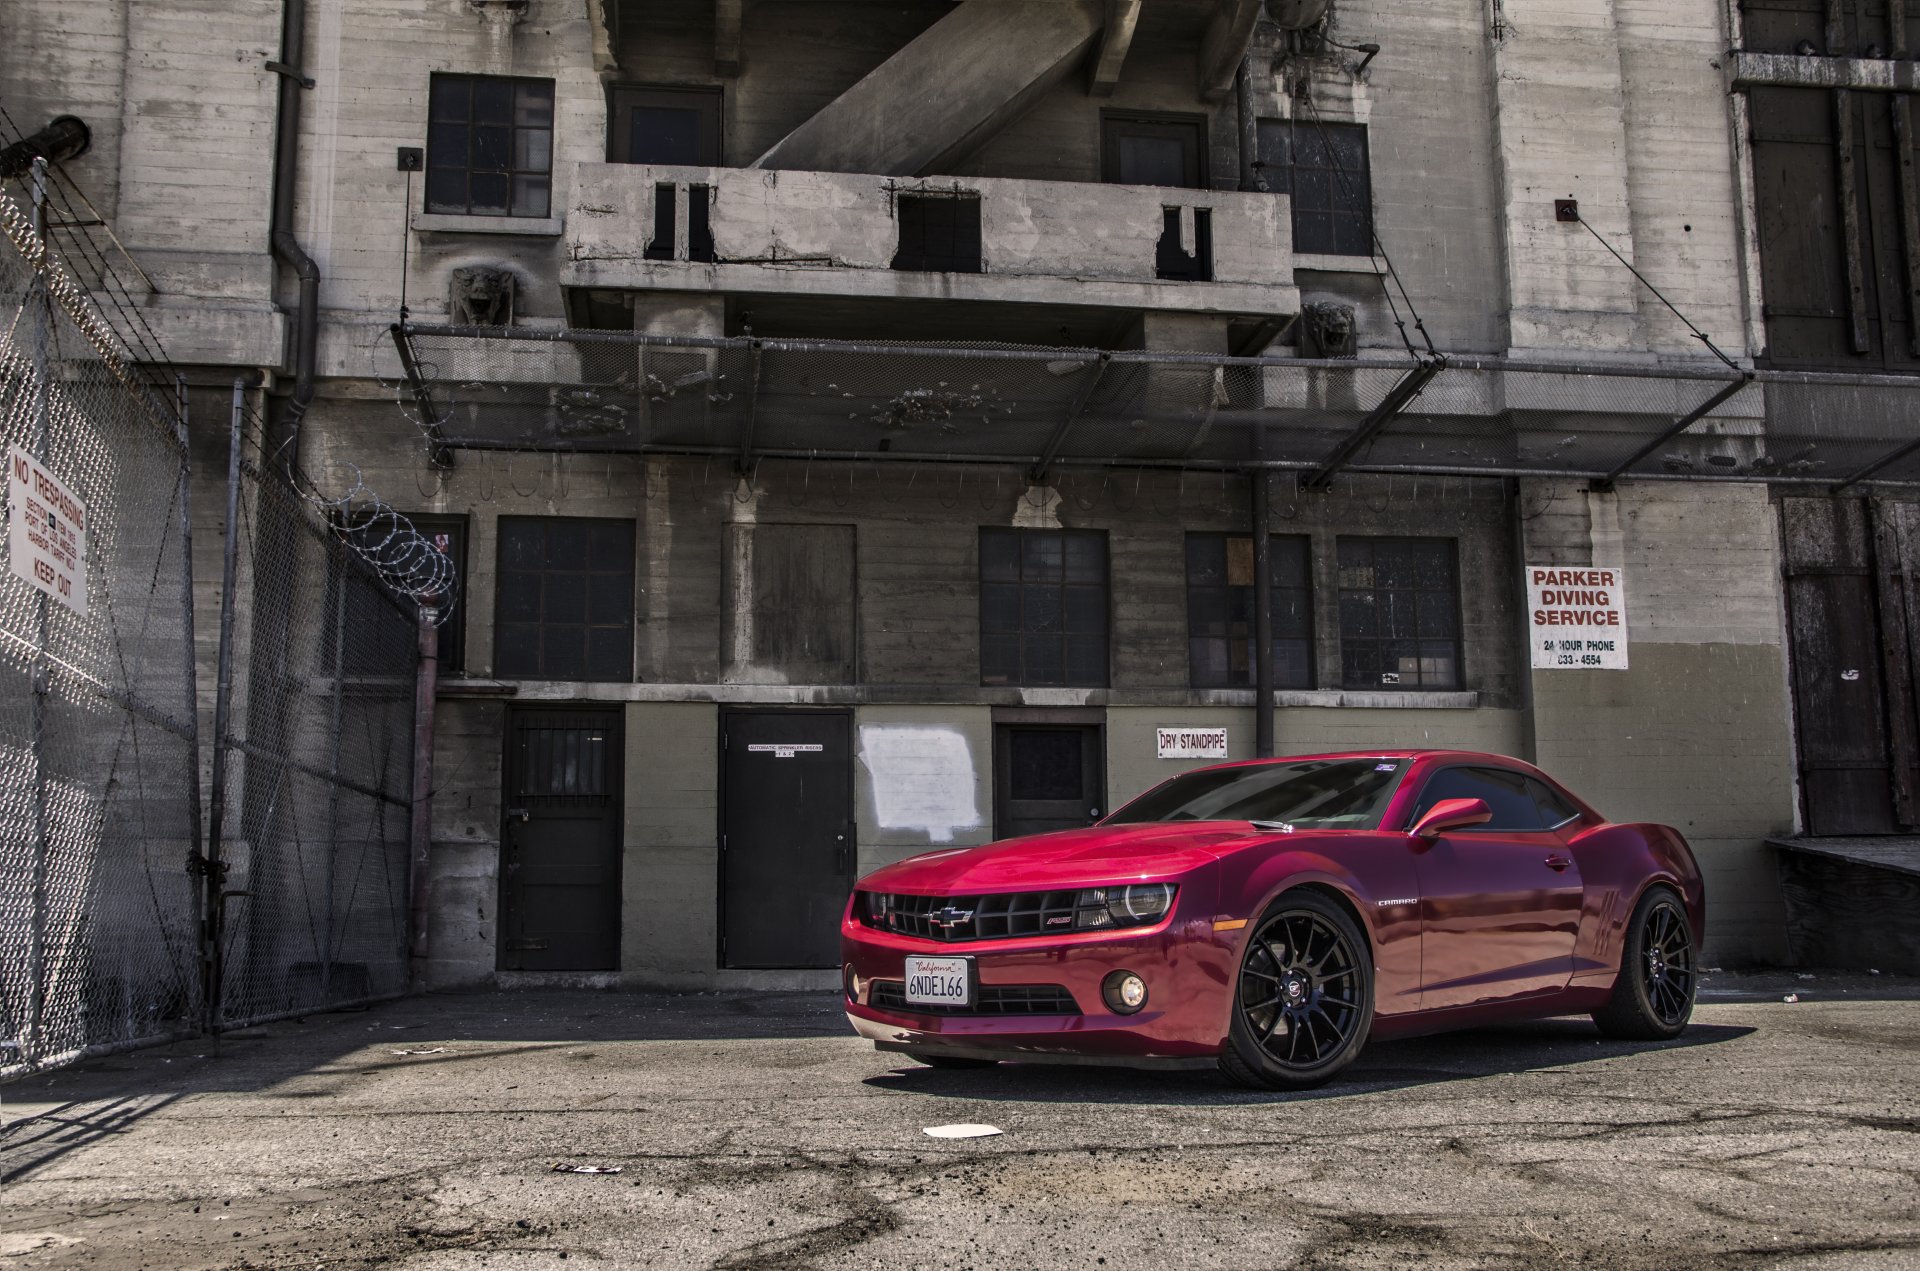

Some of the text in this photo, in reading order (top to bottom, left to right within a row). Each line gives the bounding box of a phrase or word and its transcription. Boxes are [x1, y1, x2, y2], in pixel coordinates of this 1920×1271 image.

[14, 454, 84, 530] NO TRESPASSING
[25, 511, 39, 530] PORT
[50, 528, 58, 544] LOS
[34, 557, 71, 599] KEEP OUT
[1533, 570, 1615, 587] PARKER
[1541, 590, 1610, 606] DIVING
[1533, 610, 1620, 626] SERVICE
[1543, 640, 1615, 651] 24 HOUR PHONE
[1160, 733, 1225, 749] DRY STANDPIPE
[1378, 898, 1418, 906] CAMARO
[917, 961, 954, 974] California
[909, 975, 963, 997] 6NDE166
